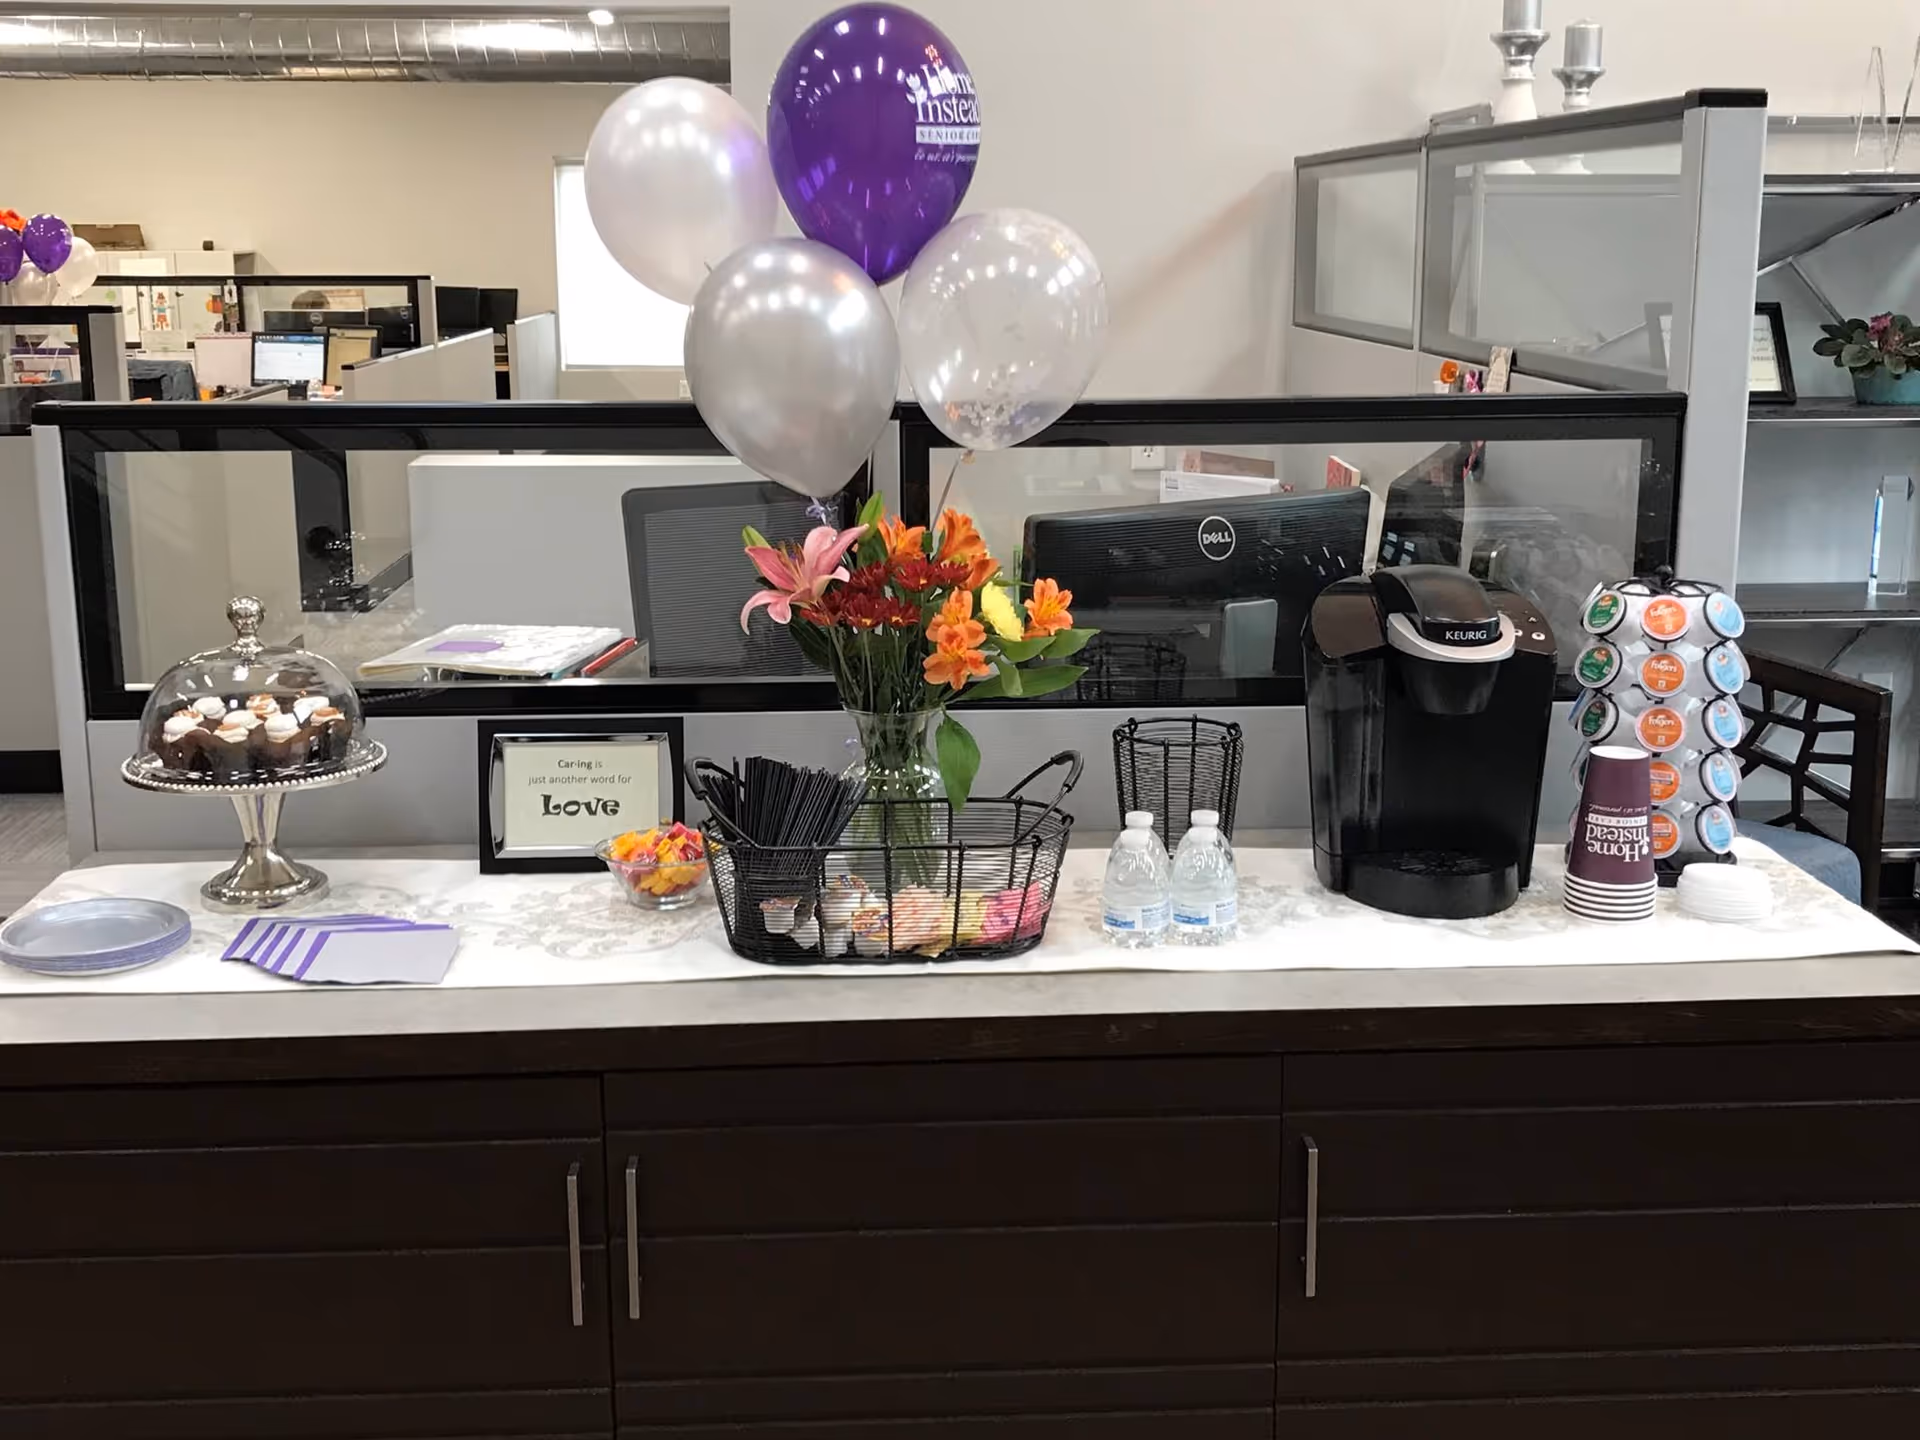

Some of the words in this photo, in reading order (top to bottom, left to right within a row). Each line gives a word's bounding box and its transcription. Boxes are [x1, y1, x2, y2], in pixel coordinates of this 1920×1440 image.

[1202, 531, 1232, 545] DELL
[1445, 630, 1487, 640] KEURIG
[594, 760, 603, 769] is
[528, 775, 546, 786] just
[549, 775, 587, 784] another
[590, 774, 616, 784] word
[618, 774, 632, 784] for
[540, 793, 620, 817] Love
[1585, 824, 1648, 842] Instead
[1587, 840, 1640, 862] Home
